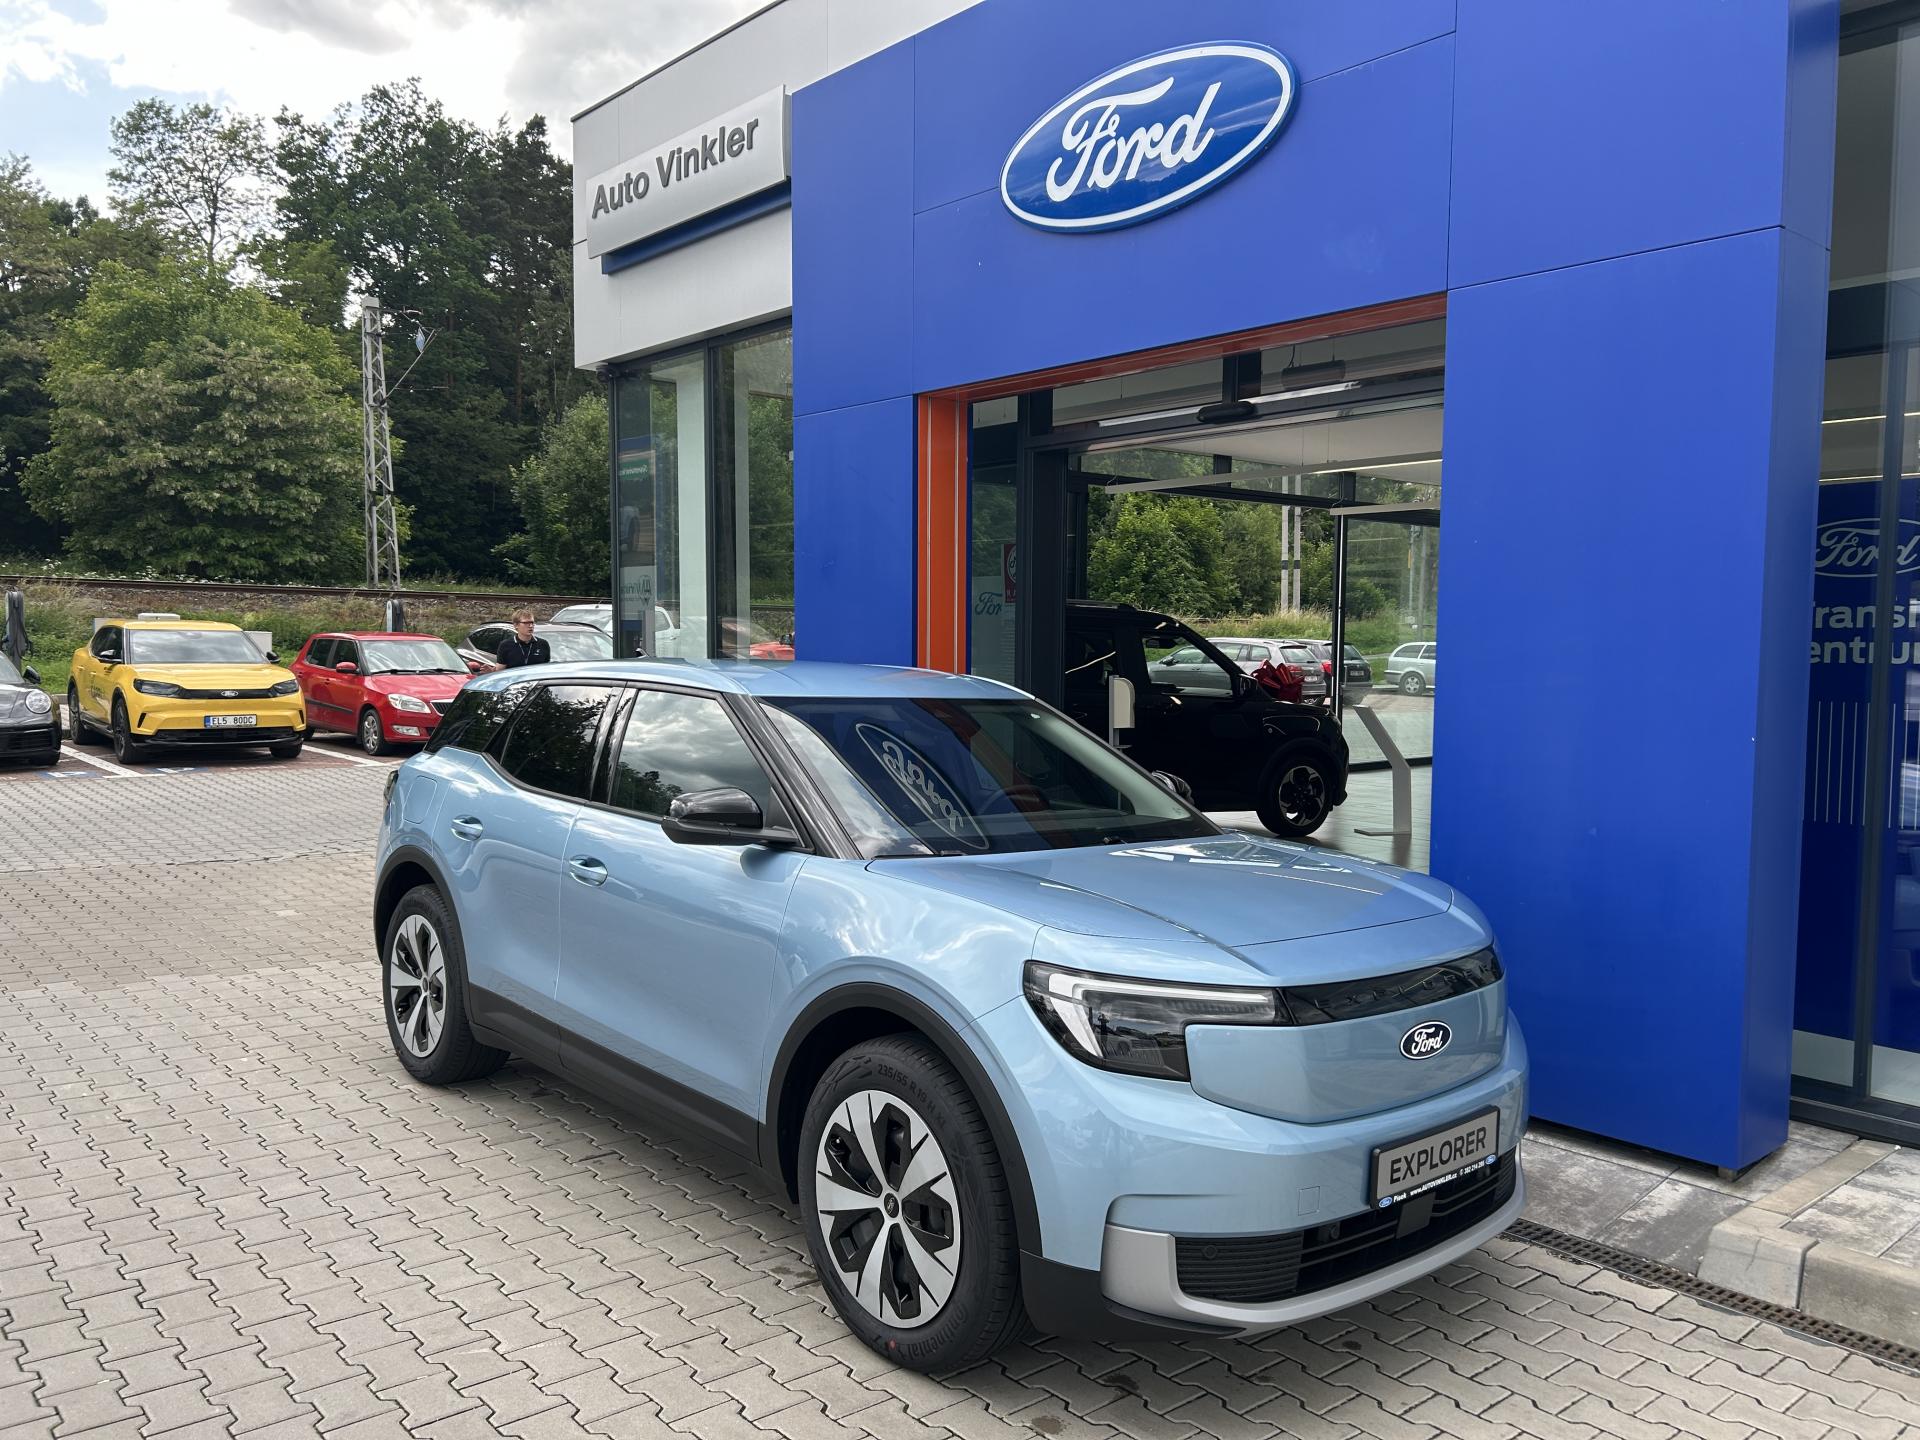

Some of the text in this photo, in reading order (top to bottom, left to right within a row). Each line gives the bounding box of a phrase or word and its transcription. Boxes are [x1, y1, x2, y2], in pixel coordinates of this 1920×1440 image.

[1046, 77, 1221, 202] Ford
[592, 118, 759, 219] Auto Vinkler
[975, 591, 1003, 615] For
[1411, 1026, 1443, 1054] Ford
[878, 1063, 908, 1087] 235/55
[1390, 1126, 1487, 1184] EXPLORER
